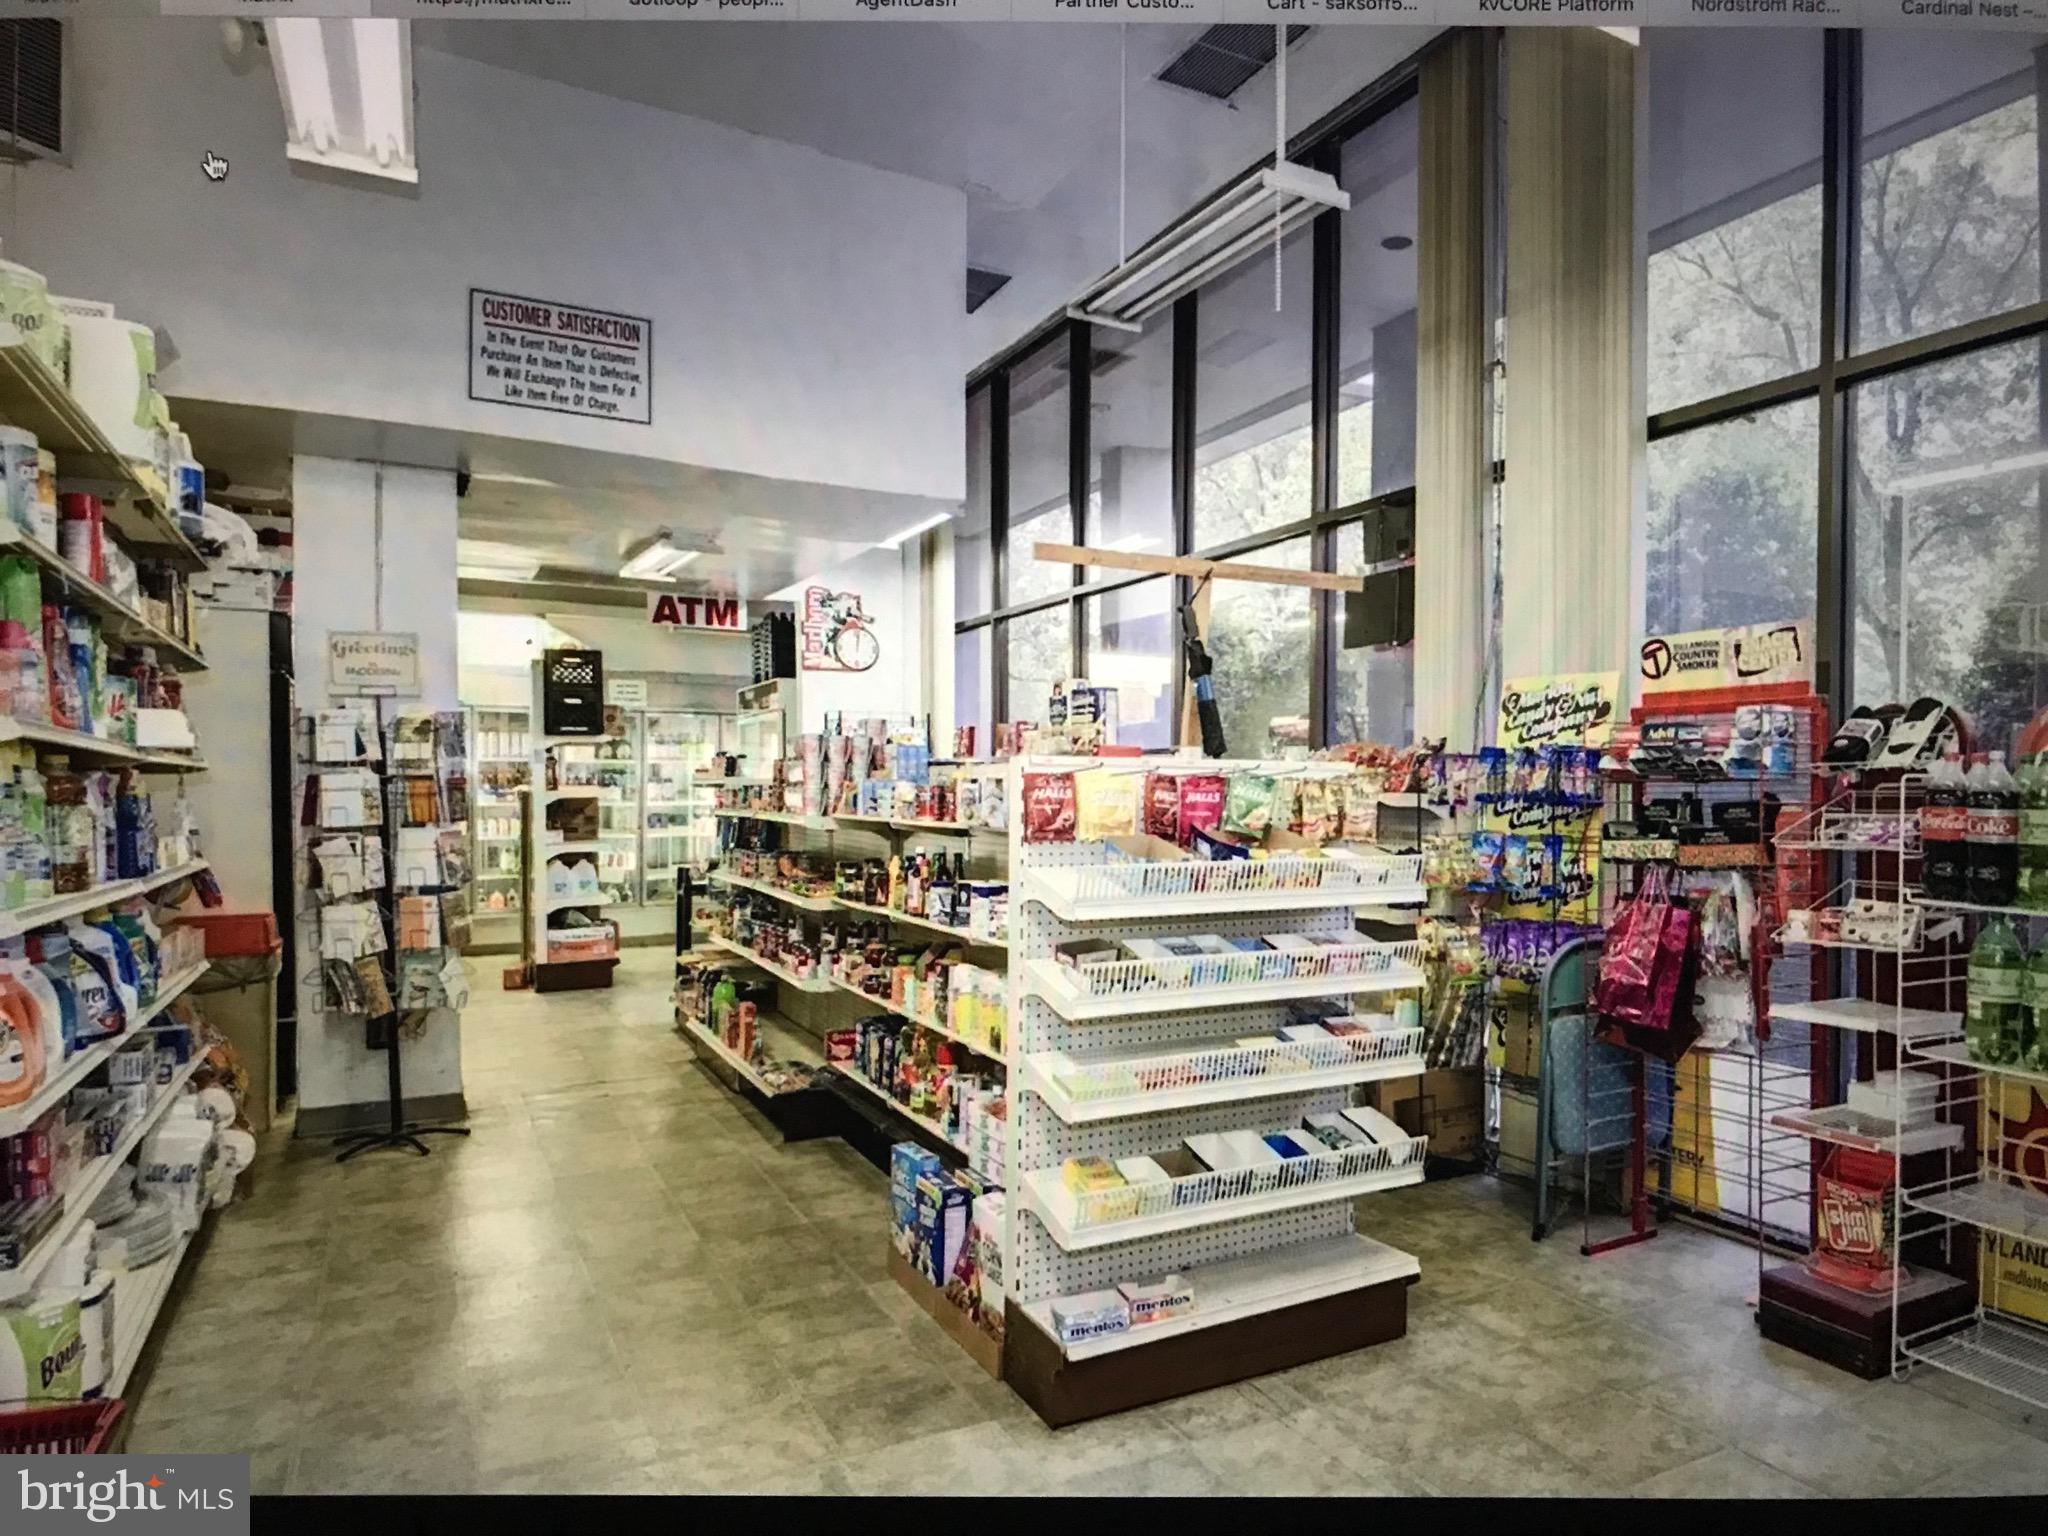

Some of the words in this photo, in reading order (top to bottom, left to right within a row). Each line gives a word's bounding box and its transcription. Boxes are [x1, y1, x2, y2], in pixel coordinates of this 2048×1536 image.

[1267, 0, 1305, 10] Cart
[1479, 0, 1551, 12] kvCORE
[1557, 0, 1634, 12] Platform
[1692, 0, 1787, 12] Nordstrom
[1901, 0, 1973, 16] Cardinal
[1979, 2, 2019, 18] Nest
[482, 298, 551, 328] CUSTOMER
[557, 311, 640, 342] SATISFACTION
[487, 330, 496, 343] In
[501, 332, 516, 346] The
[520, 336, 545, 350] Event
[549, 339, 568, 354] That
[572, 344, 587, 358] Our
[591, 347, 636, 366] Customers
[480, 346, 522, 364] Purchase
[526, 354, 538, 367] An
[542, 356, 562, 370] Item
[566, 360, 585, 374] That
[588, 364, 597, 376] Is
[600, 366, 642, 385] Defective,
[486, 365, 500, 379] We
[503, 367, 521, 381] Will
[524, 370, 566, 389] Exchange
[570, 377, 586, 391] The
[589, 381, 609, 394] Item
[612, 384, 626, 398] For
[630, 387, 636, 398] A
[505, 384, 523, 398] Like
[527, 388, 547, 401] Item
[551, 391, 569, 405] Free
[573, 394, 584, 406] Of
[588, 396, 620, 413] Charge.
[653, 595, 739, 627] ATM
[331, 640, 416, 659] Greetings
[1672, 650, 1719, 663] COUNTRY
[1676, 660, 1719, 672] SMOKER
[1518, 709, 1600, 743] Company
[1032, 787, 1072, 800] HALLS
[1185, 791, 1220, 803] HALLS
[1967, 819, 2010, 834] Coke
[1136, 1294, 1191, 1312] mentos
[1070, 1320, 1124, 1337] mentos
